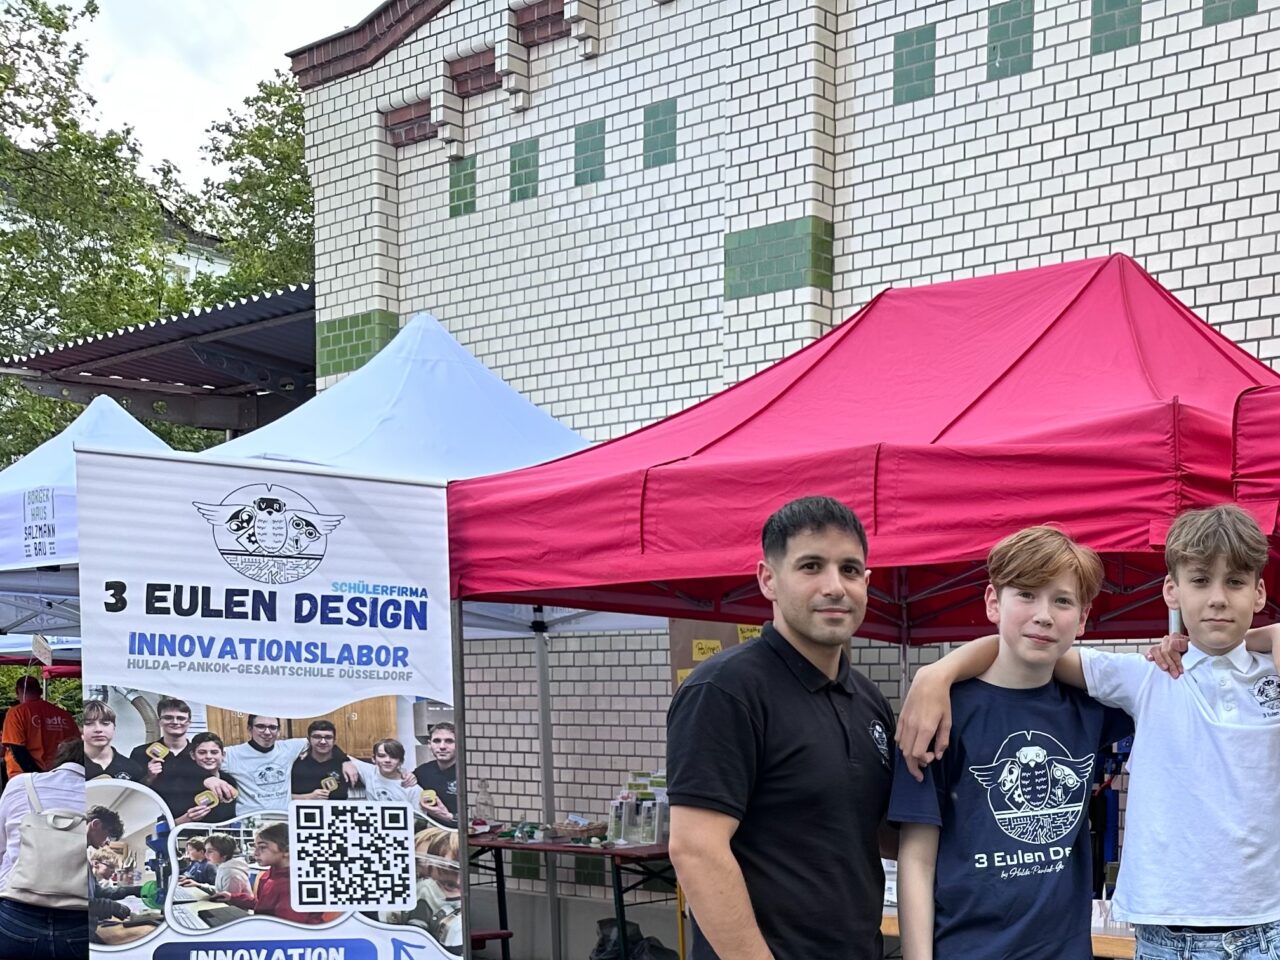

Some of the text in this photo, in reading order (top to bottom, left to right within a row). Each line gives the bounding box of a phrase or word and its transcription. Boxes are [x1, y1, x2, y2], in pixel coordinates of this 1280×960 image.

[30, 506, 47, 521] HAUS
[24, 523, 55, 541] SALZMANN
[33, 541, 47, 557] BAU
[331, 580, 428, 599] SCHÜLERFIRMA
[104, 580, 128, 613] 3
[145, 583, 278, 622] EULEN
[294, 592, 428, 631] DESIGN
[128, 631, 409, 668] INNOVATIONSLABOR
[127, 658, 413, 682] HULDA-PANKOK-GESAMTSCHULE DÜSSELDORF
[974, 853, 988, 868] 3
[993, 849, 1046, 867] Eulen
